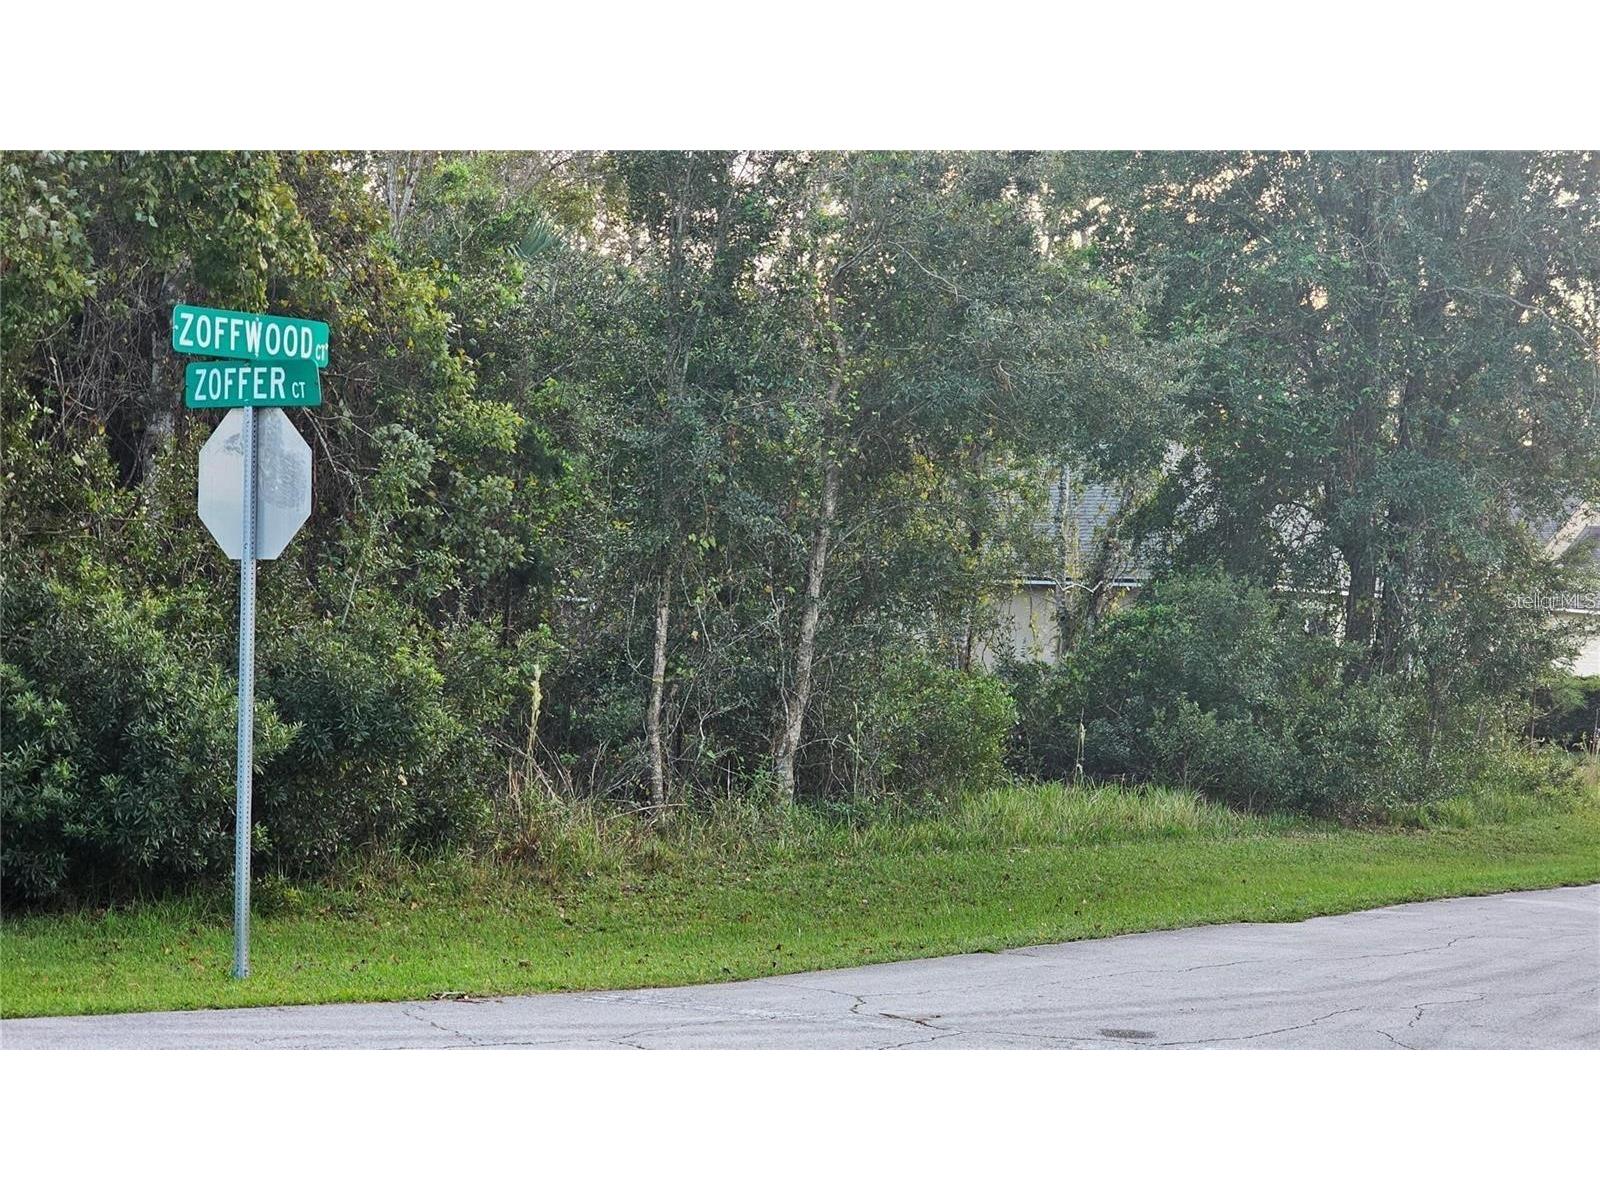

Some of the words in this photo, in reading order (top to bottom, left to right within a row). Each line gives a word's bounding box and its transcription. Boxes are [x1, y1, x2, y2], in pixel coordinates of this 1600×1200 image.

[179, 312, 313, 359] ZOFFWOOD
[315, 343, 326, 361] CT
[194, 367, 285, 401] ZOFFER
[291, 381, 306, 399] CT
